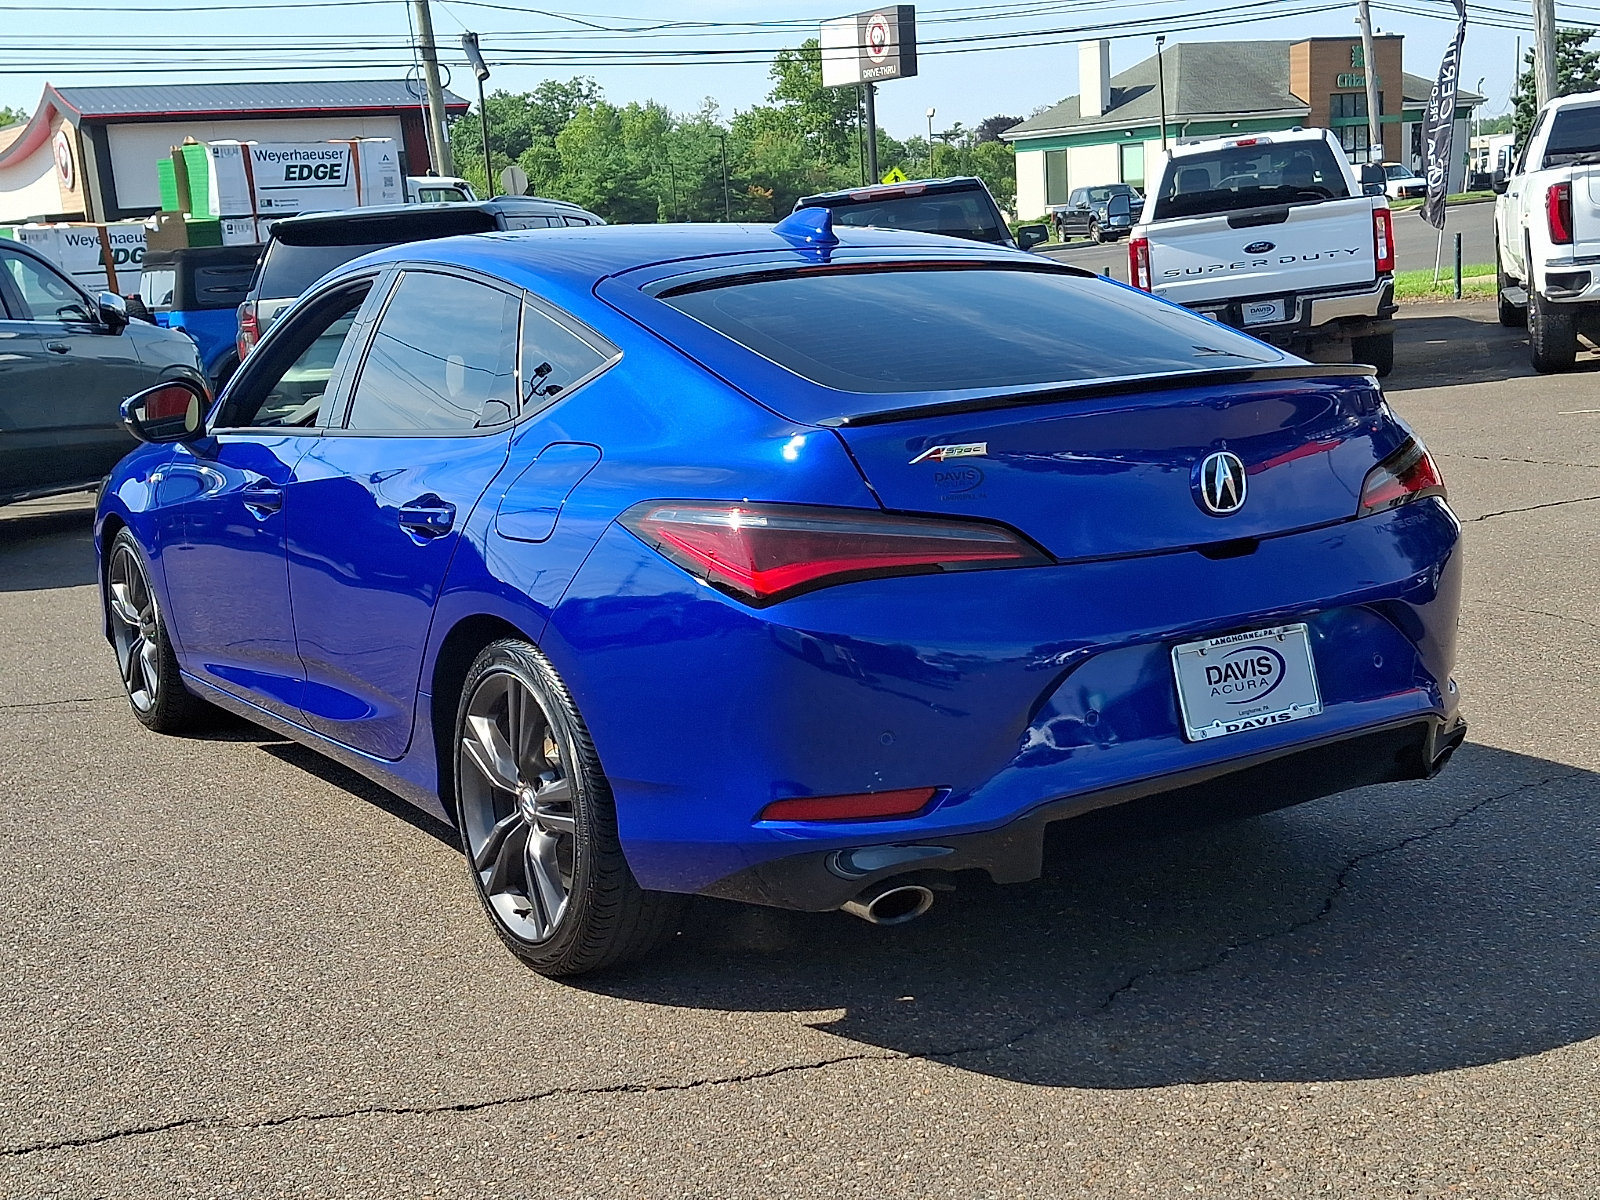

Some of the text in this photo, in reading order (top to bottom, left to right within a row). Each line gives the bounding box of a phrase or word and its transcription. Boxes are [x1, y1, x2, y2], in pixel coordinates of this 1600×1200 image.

[863, 64, 897, 79] DRIVE-THRU
[254, 149, 344, 164] Weyerhaeuser
[284, 163, 342, 181] EDGE
[1163, 247, 1360, 278] SUPER DUTY
[1250, 305, 1272, 314] DAVIS
[934, 469, 976, 482] DAVIS
[1205, 655, 1273, 686] DAVIS
[1210, 677, 1270, 697] ACURA
[1225, 712, 1292, 733] DAVIS
